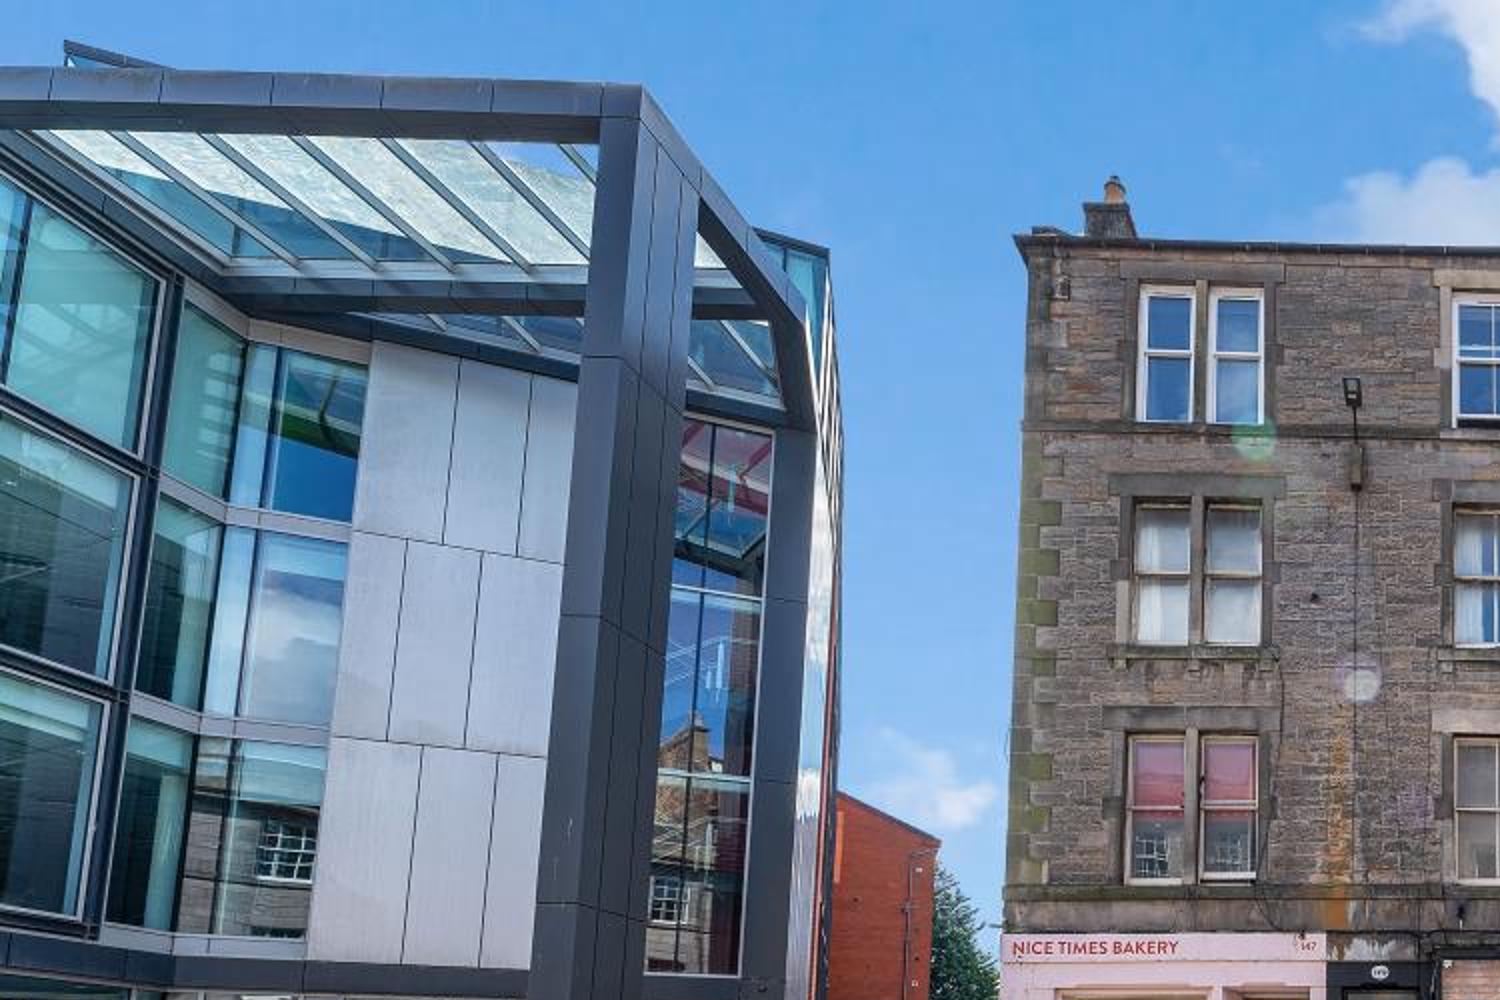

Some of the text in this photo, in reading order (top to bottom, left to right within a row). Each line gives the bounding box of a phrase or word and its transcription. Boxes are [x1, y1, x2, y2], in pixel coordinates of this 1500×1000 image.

[1013, 941, 1179, 955] NICE TIMES BAKERY
[1301, 941, 1317, 951] 147
